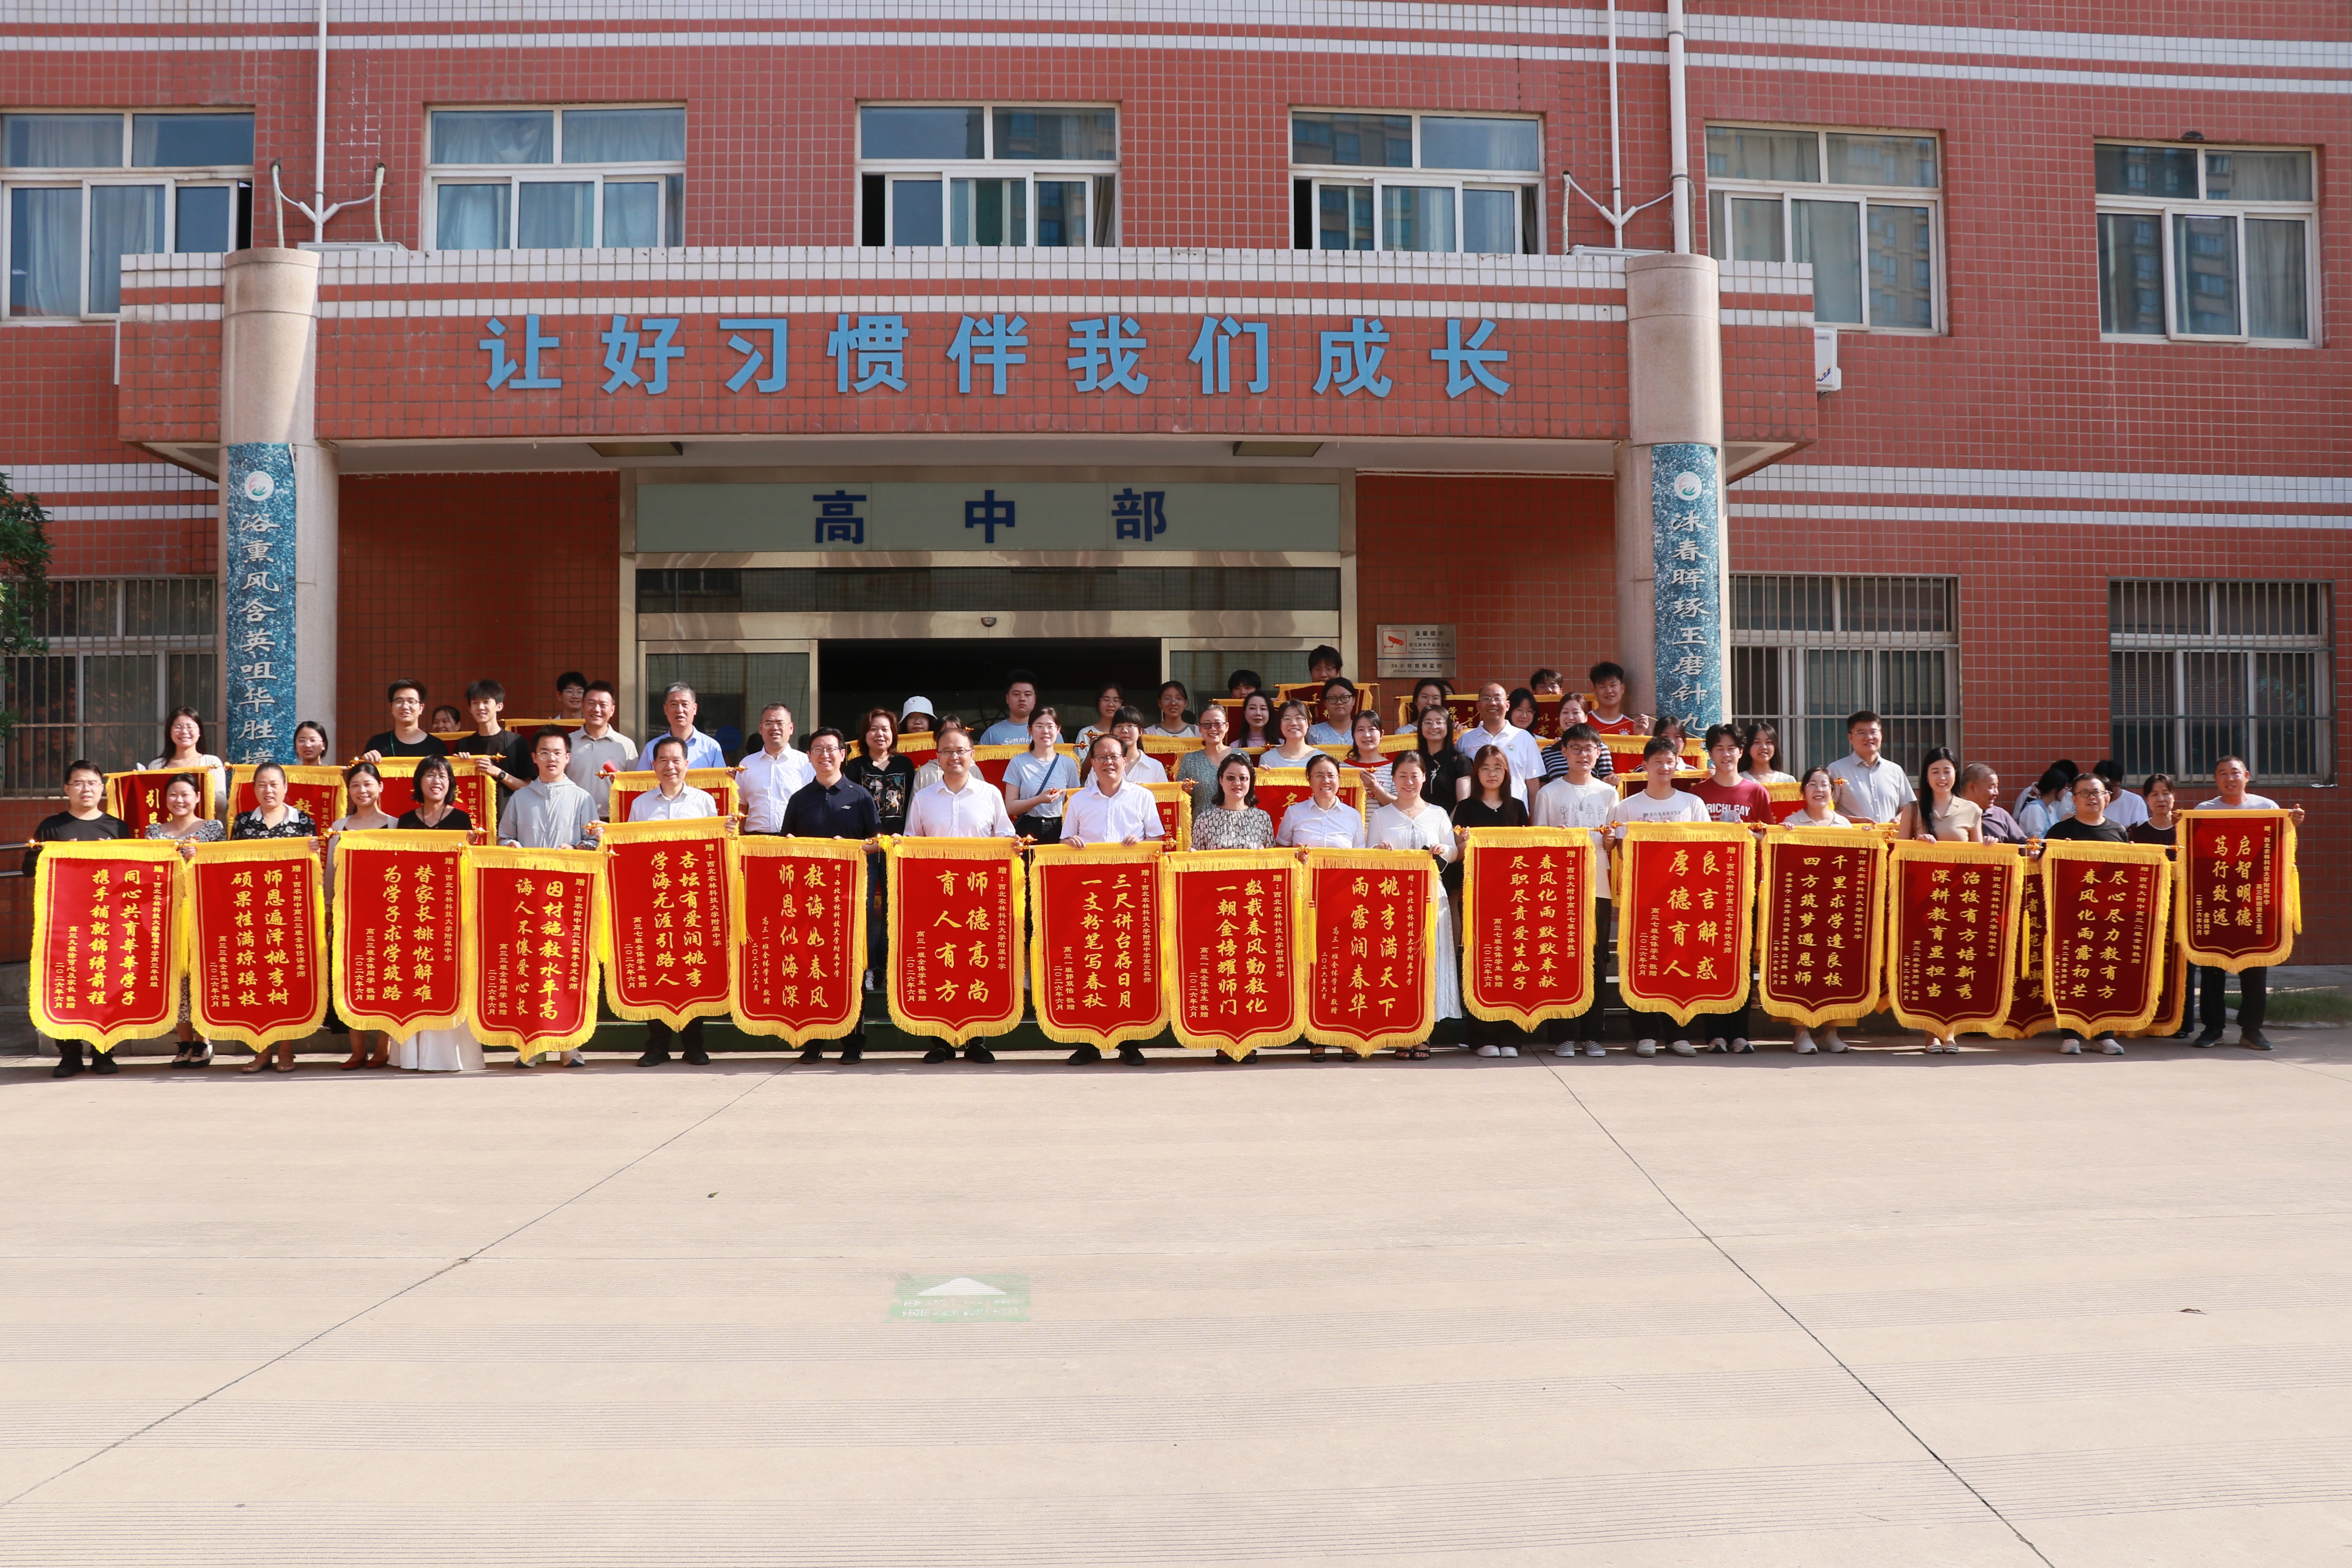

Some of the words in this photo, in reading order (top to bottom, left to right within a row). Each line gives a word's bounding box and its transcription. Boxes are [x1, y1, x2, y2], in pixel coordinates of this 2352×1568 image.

[480, 314, 1511, 399] 让好习惯伴我们成长
[812, 488, 1168, 544] 高中部
[119, 869, 142, 1005] 同心共育莘莘学子
[231, 871, 262, 1007] 硕果挂满琼瑶枝
[263, 869, 290, 1005] 师恩遍泽桃李树
[382, 865, 403, 1001] 为学子求学筑路
[412, 864, 436, 1003] 替家长排忧解难
[514, 878, 535, 1016] 诲人不倦爱心长
[651, 851, 680, 986] 学海无涯引路人
[678, 851, 706, 987] 杏坛有爱润桃李
[779, 864, 800, 1008] 师恩似海深
[804, 863, 829, 1008] 教诲如春风
[933, 870, 962, 1002] 育人有方
[966, 871, 991, 1003] 师德高尚
[1080, 879, 1107, 1009] 一支粉笔写春秋
[1111, 874, 1136, 1008] 三尺讲台存日月
[1243, 878, 1269, 1013] 数载春风勤教化
[1348, 876, 1371, 1019] 雨露润春华
[1377, 875, 1400, 1017] 桃李满天下
[1509, 855, 1531, 990] 尽职尽责爱生如子
[1537, 854, 1559, 988] 春风化雨默默奉献
[1663, 849, 1692, 977] 厚德育人
[1696, 850, 1720, 980] 良言解惑
[1795, 857, 1821, 986] 四方筑梦遇恩师
[1925, 869, 1951, 997] 深耕教育显担当
[1954, 871, 1980, 999] 治校有方培新秀
[2070, 868, 2101, 997] 春风化雨露初芒
[2097, 870, 2129, 999] 尽心尽力教有方
[2212, 835, 2231, 926] 笃行致远
[2235, 835, 2253, 926] 启智明德
[538, 881, 565, 1020] 因材施教水平高
[1215, 886, 1240, 1015] 一朝金榜耀师门
